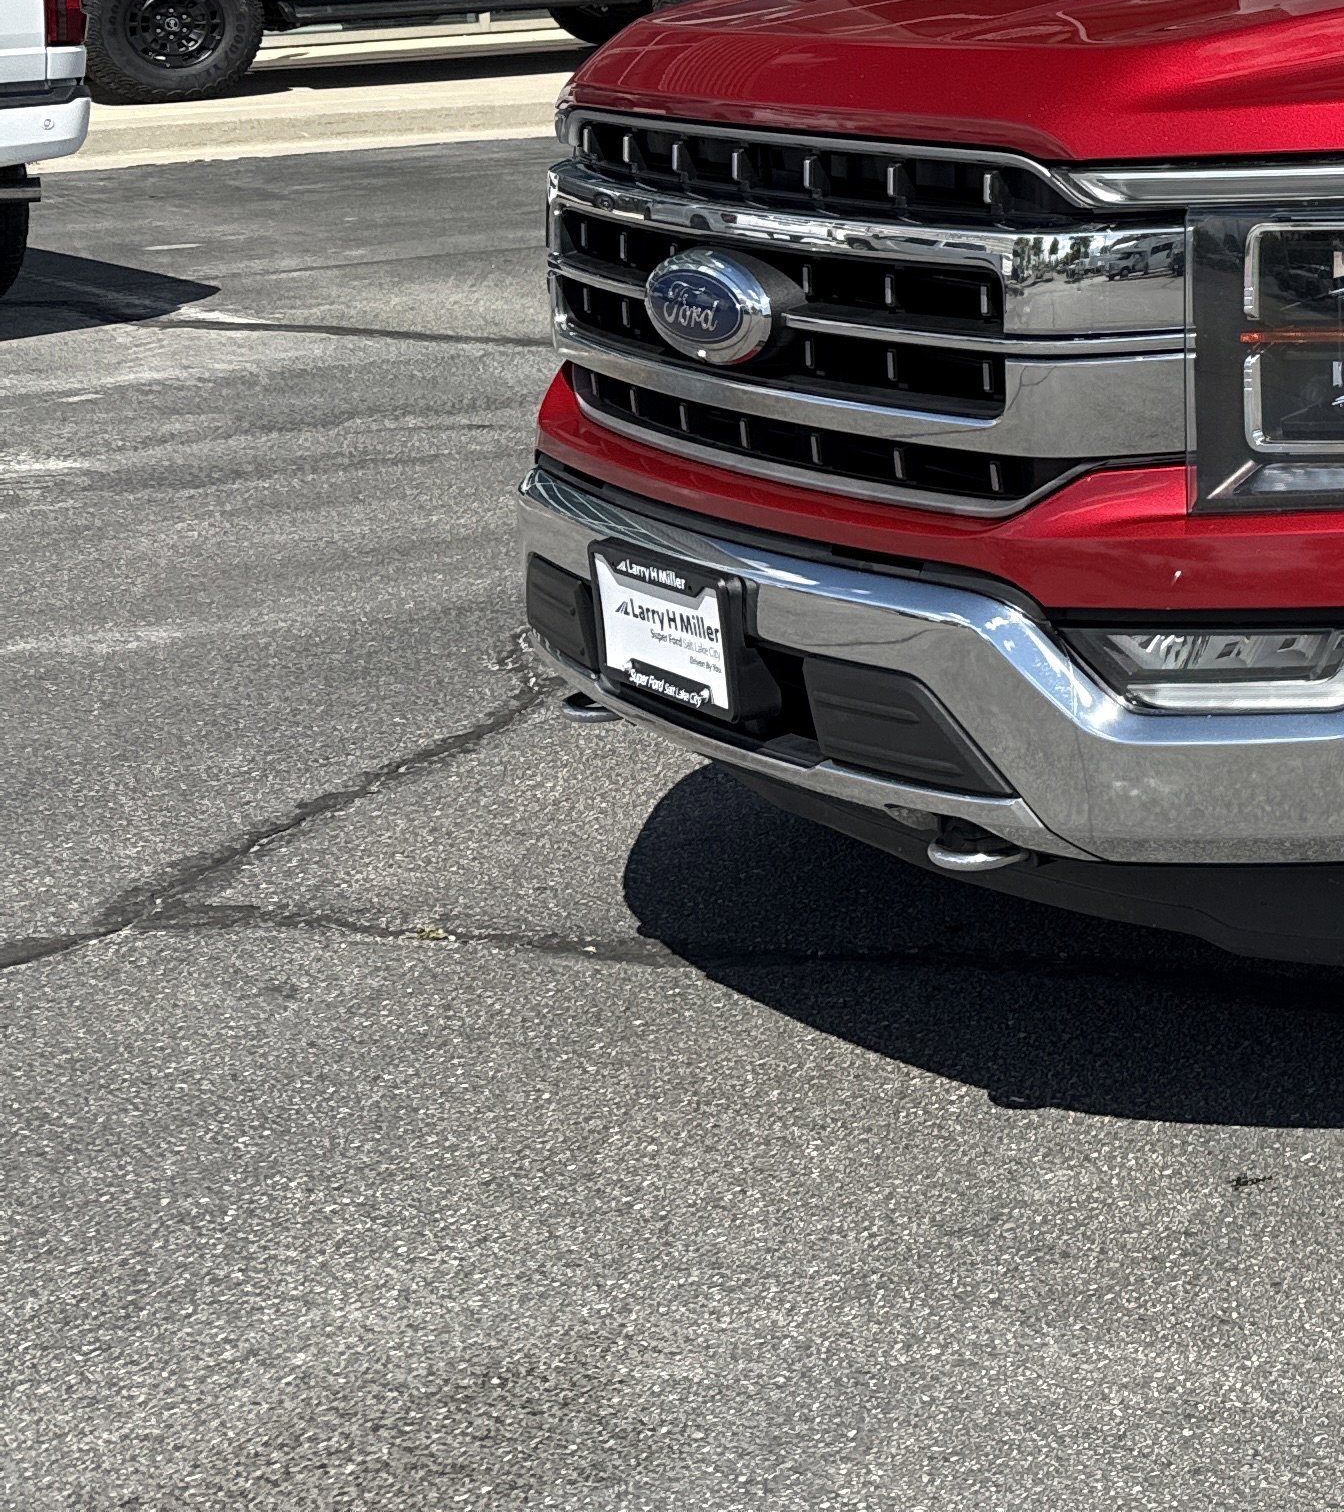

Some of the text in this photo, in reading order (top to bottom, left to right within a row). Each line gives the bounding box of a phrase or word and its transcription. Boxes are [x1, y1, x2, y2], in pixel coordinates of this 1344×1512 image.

[663, 280, 719, 332] Ford
[627, 559, 686, 590] Larry H Miller
[629, 598, 720, 643] Larry H Miller
[668, 634, 683, 648] Ford
[629, 668, 649, 687] Super
[648, 675, 665, 693] Ford
